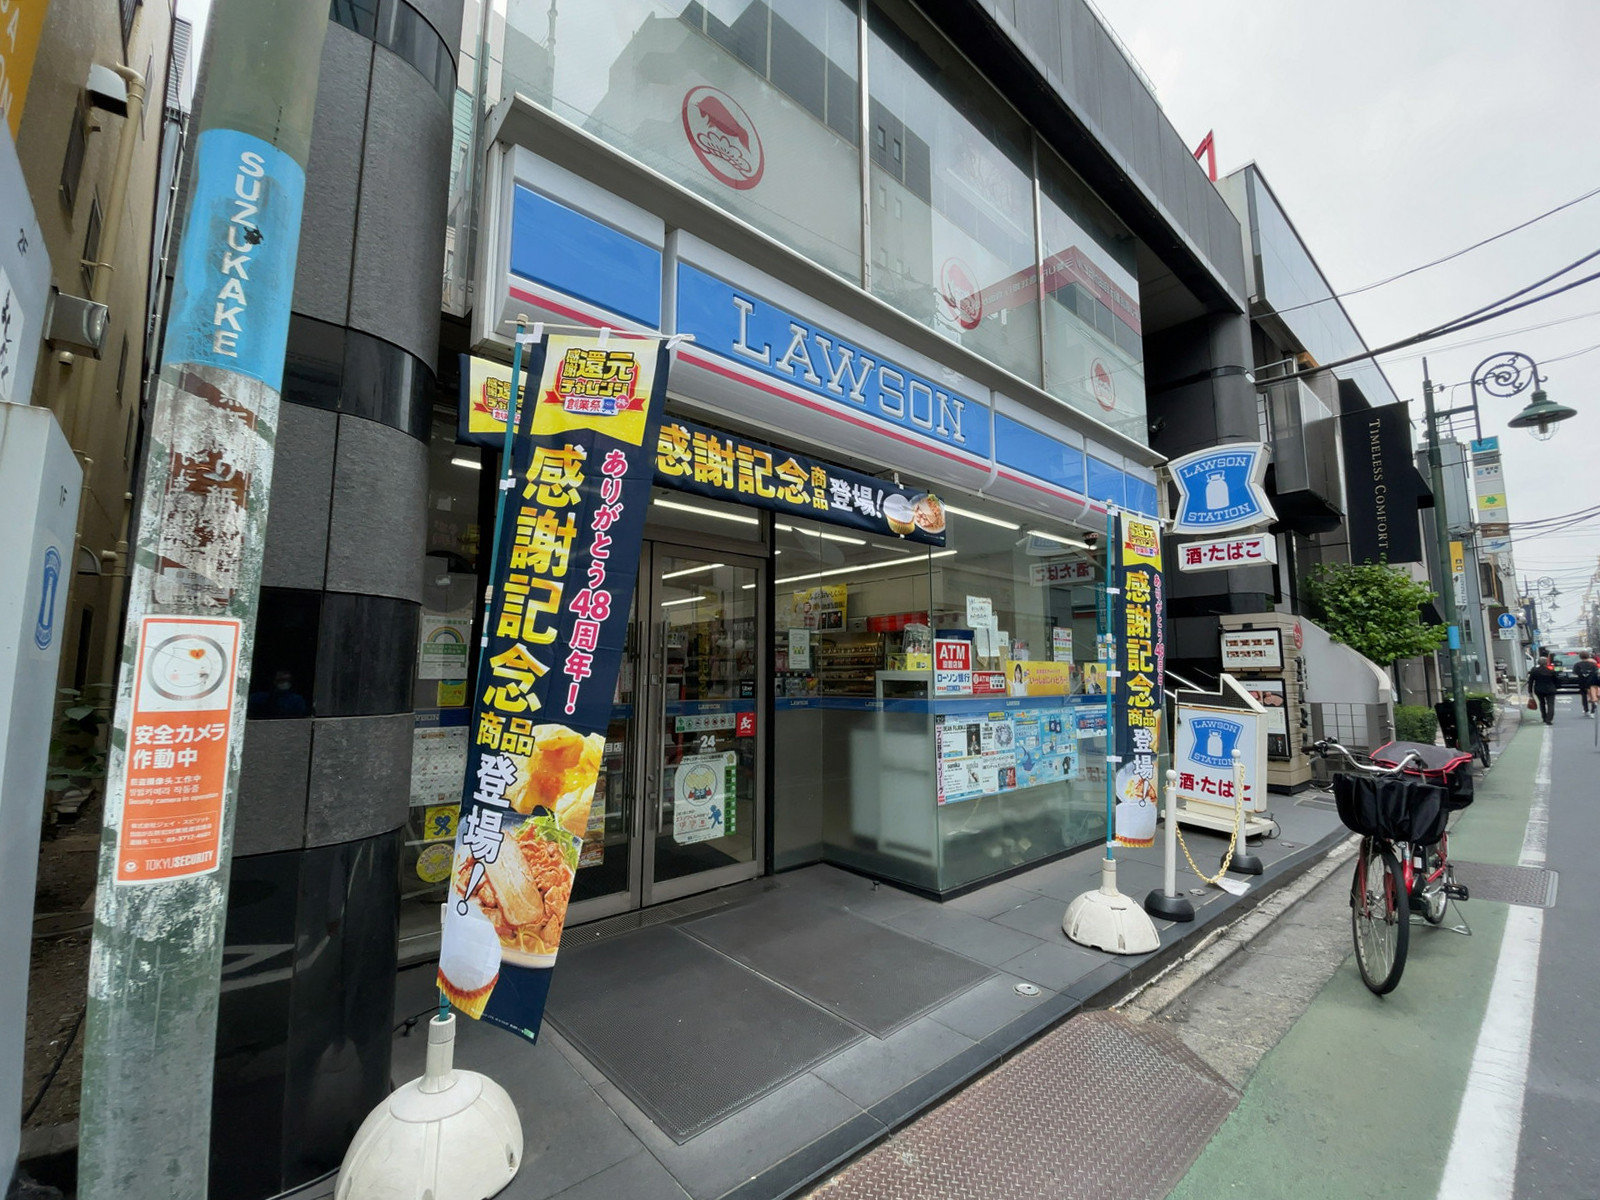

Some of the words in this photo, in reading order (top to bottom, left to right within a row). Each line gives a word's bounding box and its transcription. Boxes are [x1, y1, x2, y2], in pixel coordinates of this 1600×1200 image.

[213, 151, 265, 358] SUZUKAKE
[731, 294, 966, 443] LAWSON
[1368, 418, 1384, 482] TIMELESS
[1183, 456, 1248, 479] LAWSON
[1187, 502, 1252, 522] STATION
[1374, 484, 1389, 549] COMFORT
[939, 644, 966, 661] ATM
[937, 673, 971, 683] ローソン銀行
[134, 723, 226, 746] 安全カメラ
[1194, 720, 1238, 733] LAWSON
[700, 735, 716, 748] 24
[132, 748, 198, 770] 作動中
[1193, 752, 1236, 766] STATION
[145, 850, 214, 871] TOKYUSECURITY
